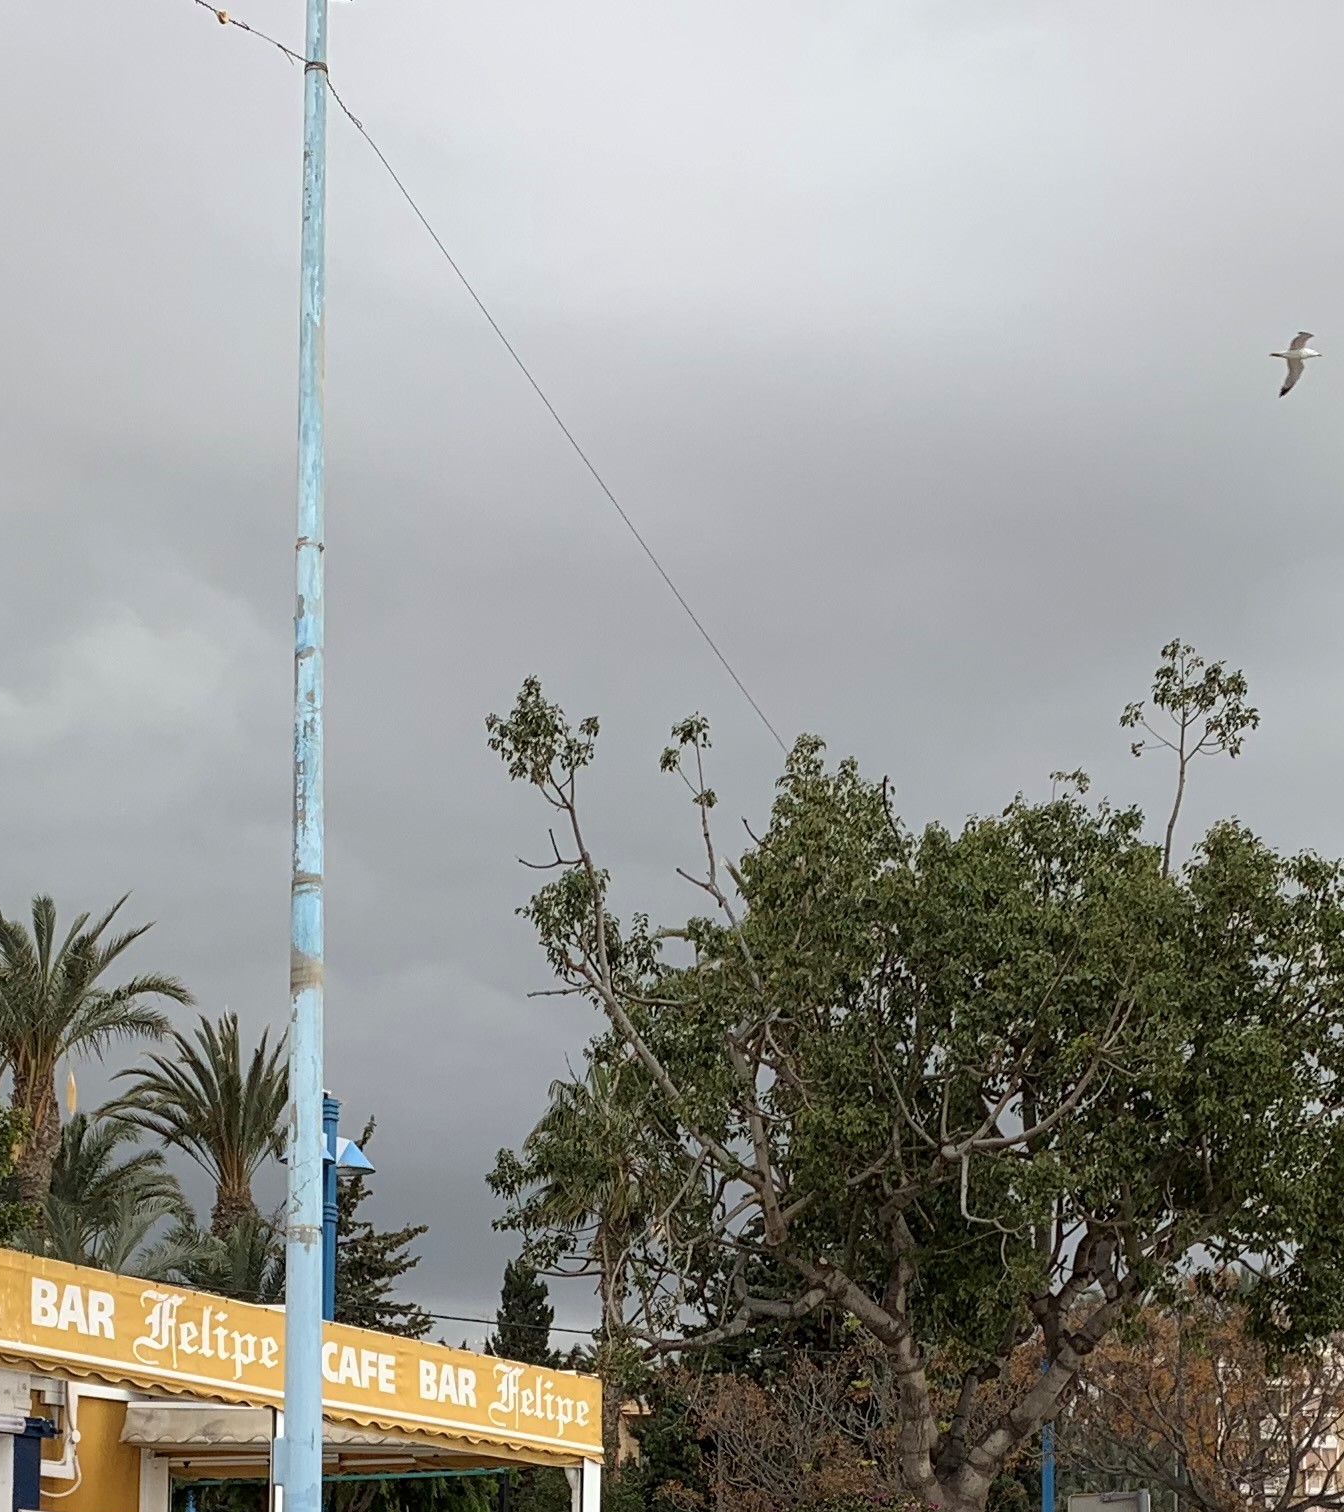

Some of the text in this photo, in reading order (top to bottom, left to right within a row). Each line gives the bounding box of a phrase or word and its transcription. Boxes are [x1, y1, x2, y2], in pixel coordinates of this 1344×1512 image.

[31, 1276, 116, 1341] BAR
[133, 1289, 279, 1381] Felipe
[321, 1341, 590, 1438] CAFE BAR Felipe
